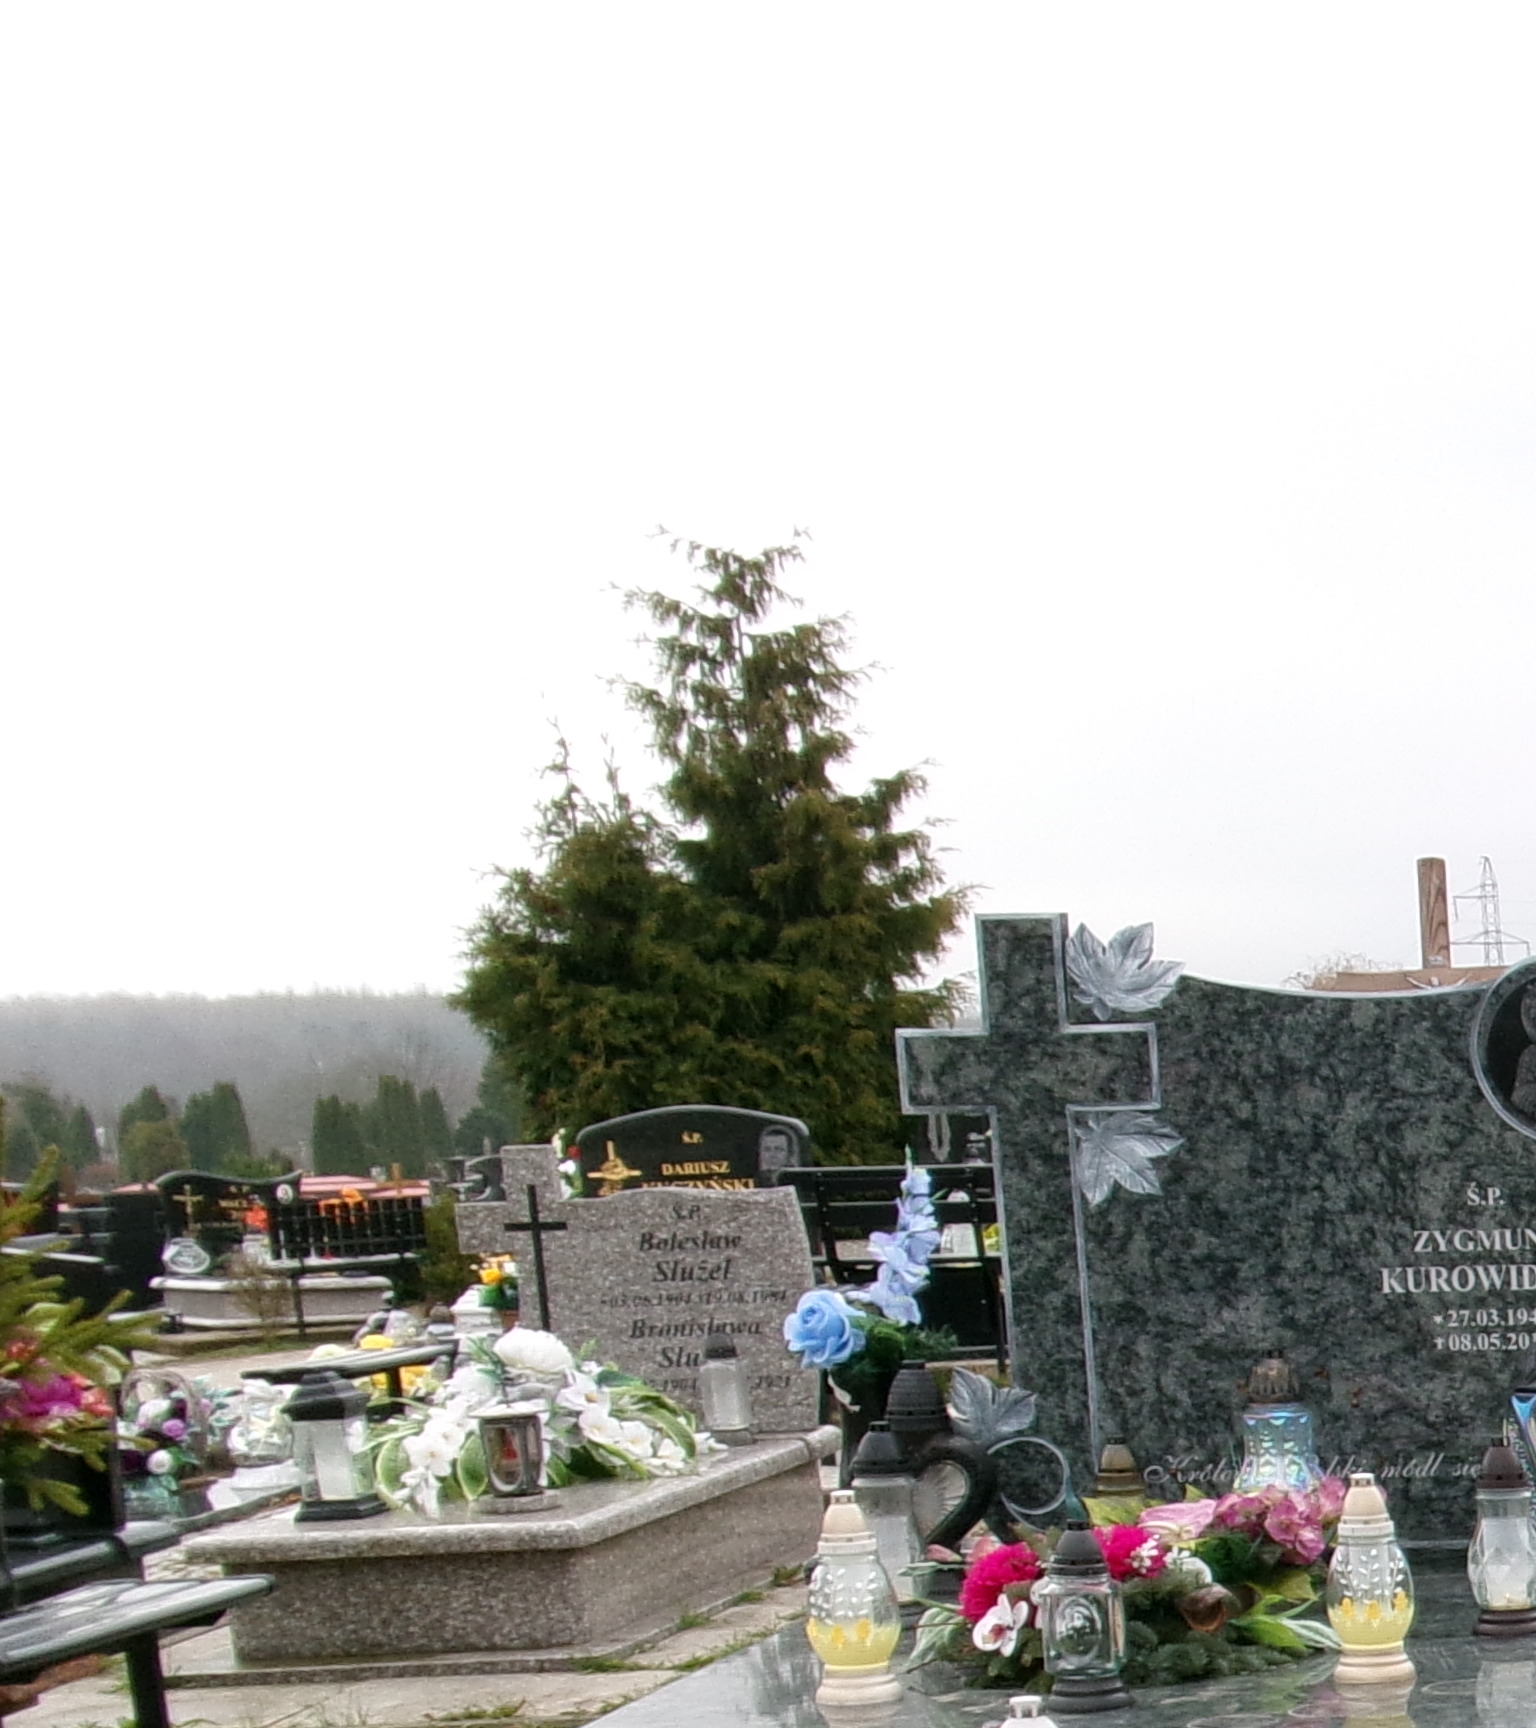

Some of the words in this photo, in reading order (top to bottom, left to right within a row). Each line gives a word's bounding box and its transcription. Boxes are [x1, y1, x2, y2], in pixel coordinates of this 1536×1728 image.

[661, 1160, 731, 1177] DARIUSZ
[1466, 1181, 1506, 1206] Ś.P.
[1380, 1452, 1445, 1480] módl
